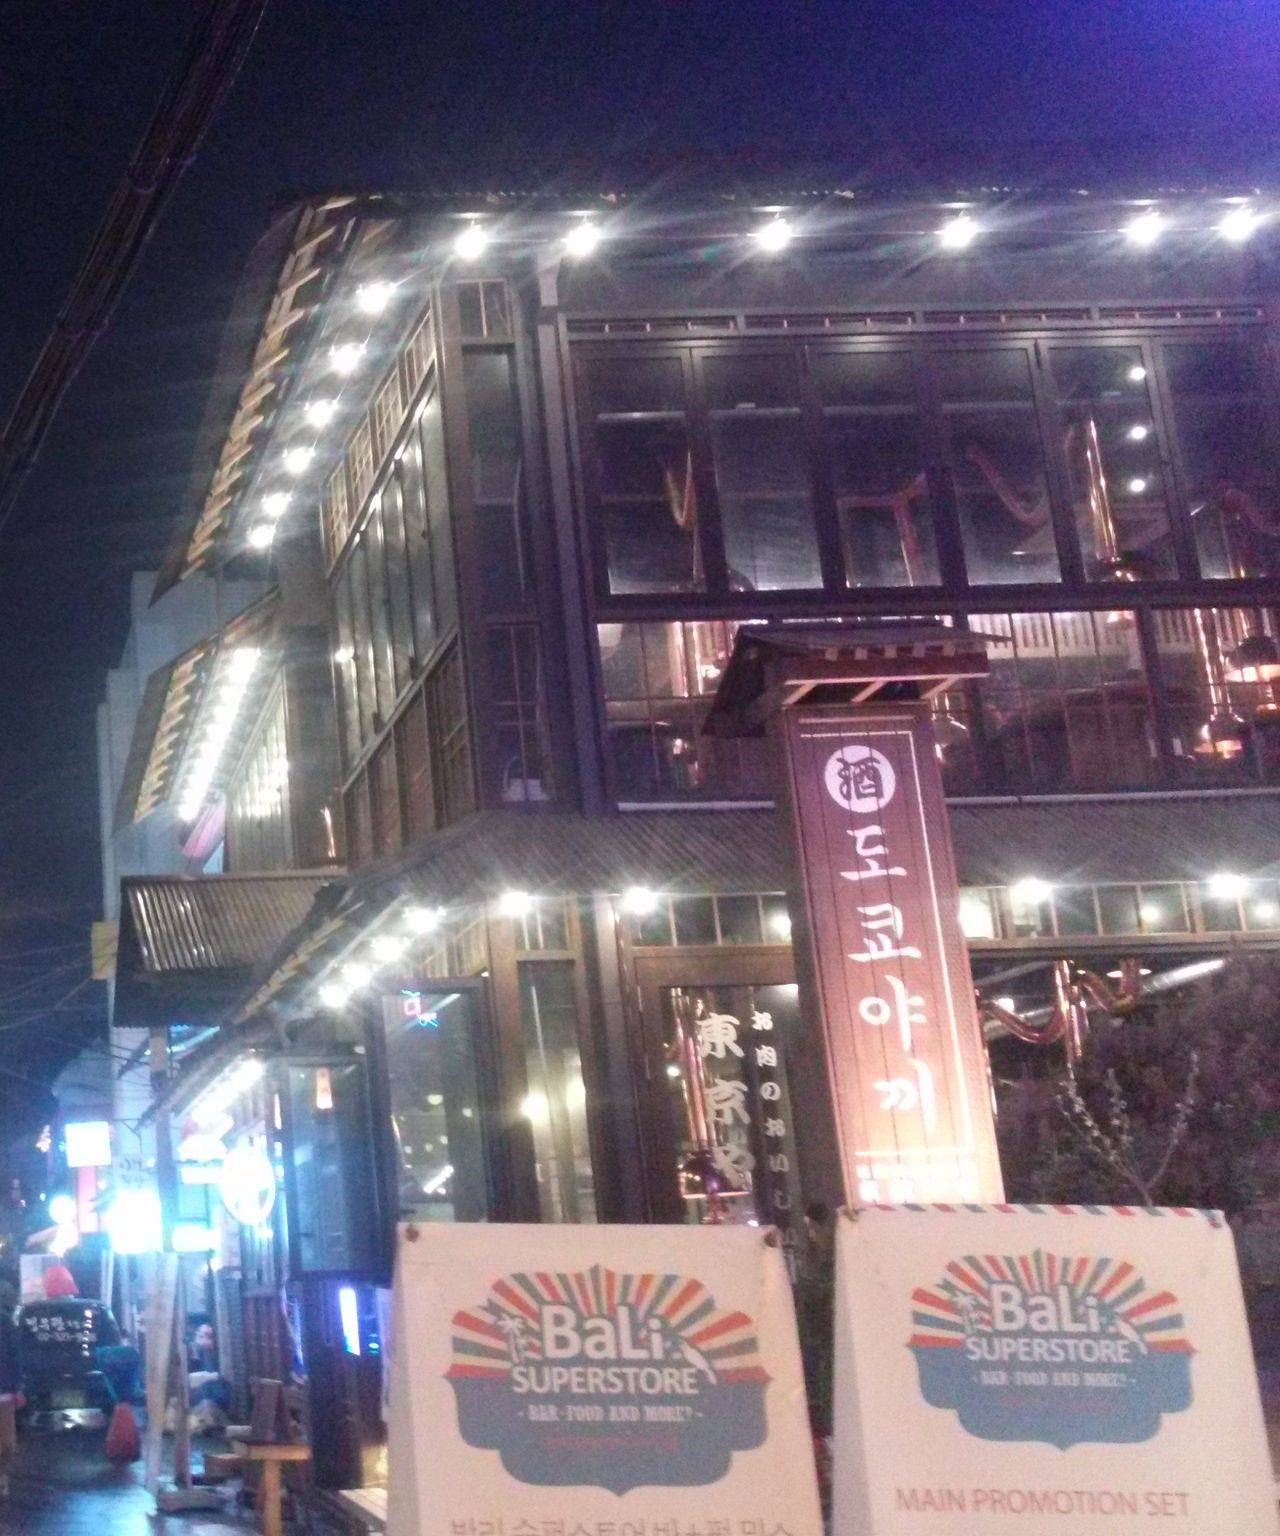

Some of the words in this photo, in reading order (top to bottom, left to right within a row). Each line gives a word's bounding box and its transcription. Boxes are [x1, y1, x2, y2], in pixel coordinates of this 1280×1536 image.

[836, 756, 884, 801] 酒
[840, 824, 936, 1135] 도쿄야끼
[966, 1337, 1132, 1363] SUPERSTORE
[511, 1366, 700, 1395] SUPERSTORE
[609, 1405, 641, 1423] AND
[896, 1488, 967, 1513] MAIN
[972, 1489, 1138, 1515] PROMOTION
[1144, 1492, 1191, 1517] SET
